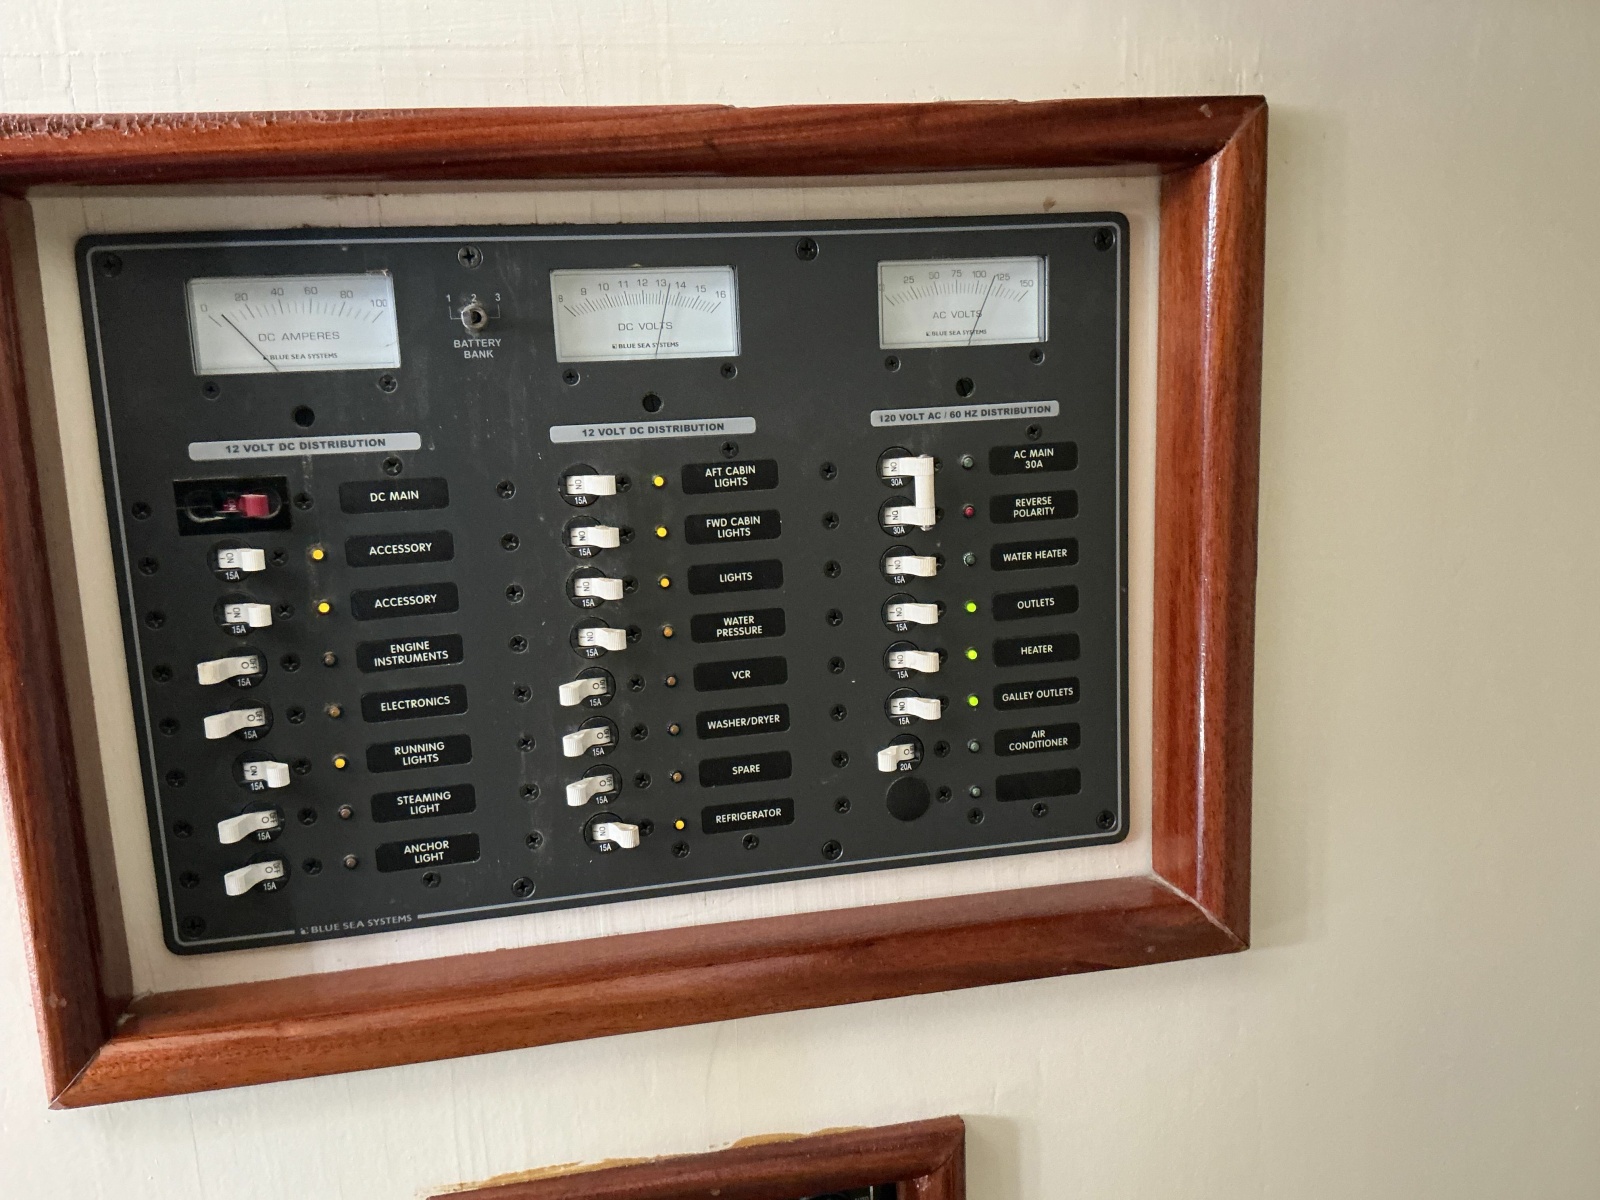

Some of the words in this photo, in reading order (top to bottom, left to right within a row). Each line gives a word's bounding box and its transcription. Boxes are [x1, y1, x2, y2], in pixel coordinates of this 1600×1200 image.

[903, 276, 914, 284] 25
[996, 273, 1010, 281] 125
[598, 283, 609, 291] 10
[656, 279, 667, 287] 13
[270, 288, 284, 297] 40
[304, 286, 318, 295] 60
[340, 290, 353, 299] 80
[234, 292, 248, 302] 20
[446, 294, 450, 302] 1
[471, 294, 476, 302] 2
[495, 293, 500, 302] 3
[200, 304, 207, 312] 0
[371, 298, 387, 308] 100
[933, 311, 946, 319] AC
[951, 310, 982, 318] VOLTS
[618, 323, 634, 331] DC
[638, 322, 673, 330] VOLTS
[258, 333, 275, 342] DC
[281, 331, 340, 341] AMPERES
[453, 338, 502, 348] BATTERY
[307, 352, 338, 360] SYSTEMS
[463, 350, 494, 359] BANK
[880, 414, 896, 422] 120
[899, 413, 925, 421] VOLT
[928, 411, 941, 420] AC
[981, 405, 1051, 416] DISTRIBUTION
[582, 429, 594, 437] 12
[598, 427, 626, 436] VOLT
[629, 427, 644, 435] DC
[648, 423, 725, 434] DISTRIBUTION
[225, 445, 239, 453] 12
[243, 442, 275, 452] VOLT
[279, 442, 295, 451] DC
[299, 438, 386, 450] DISTRIBUTION
[1013, 451, 1027, 459] AC
[1029, 448, 1054, 458] MAIN
[890, 462, 897, 472] ON
[1025, 460, 1043, 469] 30A
[705, 468, 723, 478] AFT
[725, 465, 756, 476] CABIN
[574, 479, 582, 490] ON
[714, 477, 748, 488] LIGHTS
[891, 478, 903, 486] 30A
[370, 491, 386, 502] DC
[389, 490, 419, 501] MAIN
[574, 496, 587, 505] 15A
[1015, 496, 1052, 507] REVERSE
[892, 510, 899, 520] ON
[1013, 507, 1055, 518] POLARITY
[706, 518, 728, 528] FWD
[730, 516, 761, 526] CABIN
[578, 531, 586, 541] ON
[717, 528, 751, 538] LIGHTS
[369, 542, 432, 556] ACCESSORY
[579, 548, 591, 556] 15A
[1003, 552, 1032, 562] WATER
[1035, 549, 1068, 559] HEATER
[894, 560, 901, 570] ON
[225, 571, 240, 580] 15A
[719, 572, 753, 583] LIGHTS
[583, 581, 590, 592] ON
[374, 594, 437, 608] ACCESSORY
[582, 599, 595, 607] 15A
[1017, 598, 1055, 609] OUTLETS
[895, 607, 902, 617] ON
[723, 615, 755, 626] WATER
[231, 625, 246, 634] 15A
[716, 626, 763, 638] PRESSURE
[896, 623, 908, 631] 15A
[586, 631, 593, 642] ON
[390, 641, 430, 653] ENGINE
[1021, 644, 1053, 655] HEATER
[586, 648, 598, 657] 15A
[374, 650, 449, 667] INSTRUMENTS
[896, 655, 903, 664] ON
[731, 670, 751, 679] VCR
[897, 671, 909, 679] 15A
[237, 677, 252, 686] 15A
[1002, 691, 1034, 701] GALLEY
[1036, 687, 1074, 699] OUTLETS
[380, 695, 451, 712] ELECTRONICS
[589, 698, 602, 706] 15A
[898, 702, 905, 711] ON
[707, 714, 780, 730] WASHER/DRYER
[898, 717, 910, 725] 15A
[244, 730, 258, 739] 15A
[1031, 730, 1046, 738] AIR
[394, 741, 445, 755] RUNNING
[1009, 738, 1068, 751] CONDITIONER
[592, 747, 605, 756] 15A
[402, 753, 439, 766] LIGHTS
[732, 764, 761, 775] SPARE
[900, 763, 912, 771] 20A
[250, 781, 264, 791] 15A
[397, 791, 452, 806] STEAMING
[596, 796, 608, 804] 15A
[410, 803, 440, 815] LIGHT
[716, 808, 782, 824] REFRIGERATOR
[257, 831, 271, 841] 15A
[599, 826, 606, 836] ON
[403, 840, 449, 855] ANCHOR
[599, 844, 611, 852] 15A
[414, 851, 445, 864] LIGHT
[263, 882, 277, 891] 15A
[311, 923, 340, 934] BLUE
[343, 920, 364, 931] SEA
[367, 914, 412, 928] SYSTEMS
